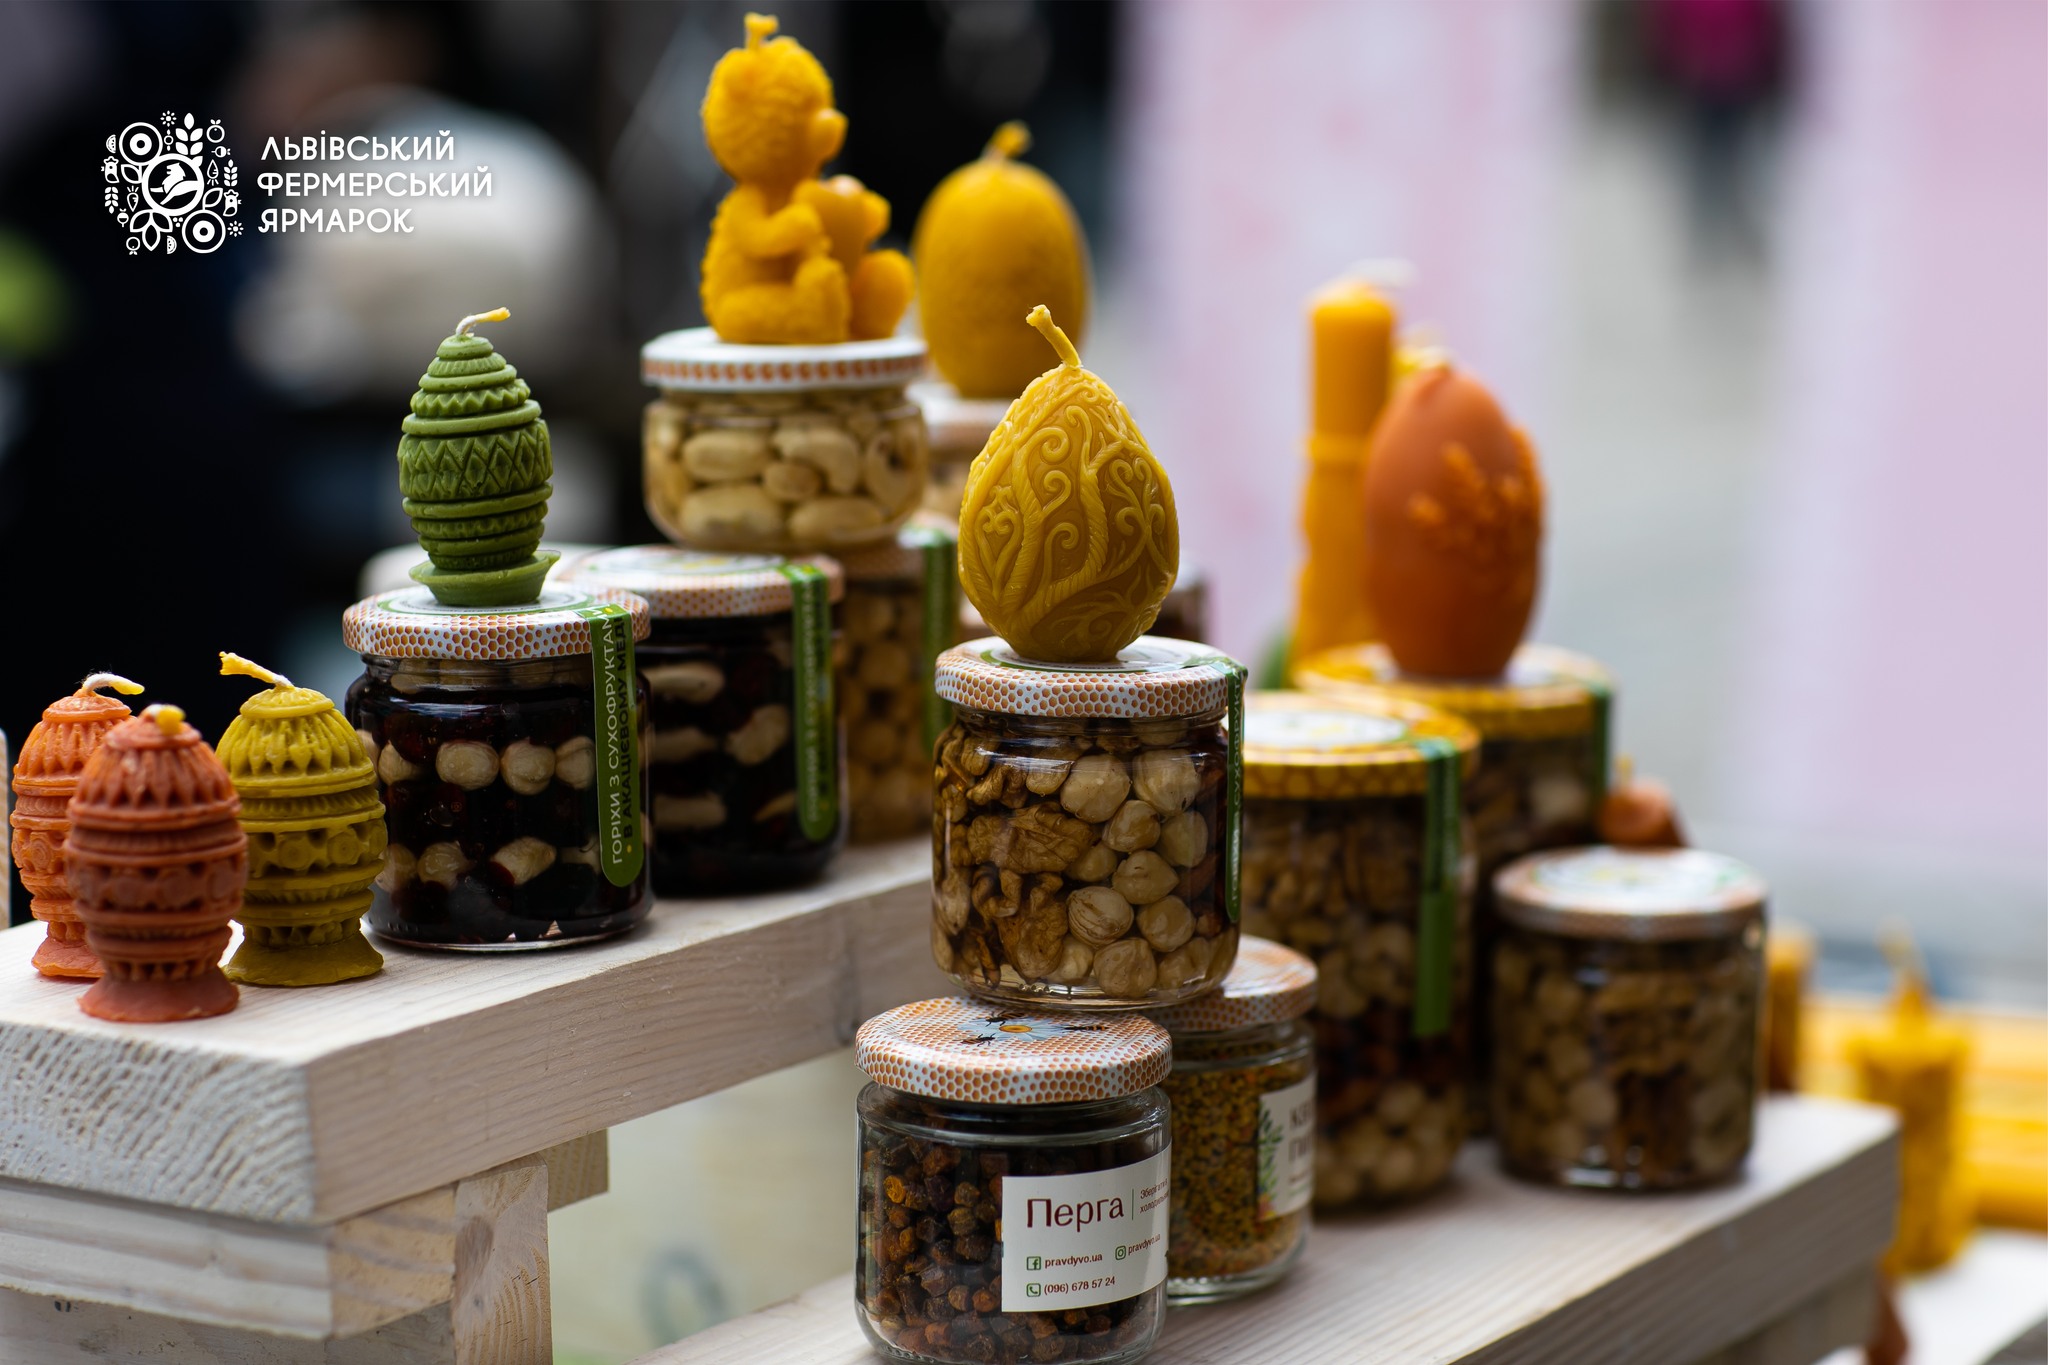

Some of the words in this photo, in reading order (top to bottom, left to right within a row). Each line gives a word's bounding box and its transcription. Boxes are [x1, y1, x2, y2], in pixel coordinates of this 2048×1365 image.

[617, 676, 633, 820] АКАЦІЄВОМУ
[611, 792, 622, 864] ГОРІХИ
[623, 827, 634, 840] В
[1027, 1197, 1124, 1232] Перга
[1045, 1254, 1103, 1269] pravdyvo.ua
[1044, 1282, 1069, 1295] (096)
[1071, 1280, 1089, 1292] 678
[1091, 1278, 1103, 1289] 57
[1105, 1276, 1115, 1286] 24
